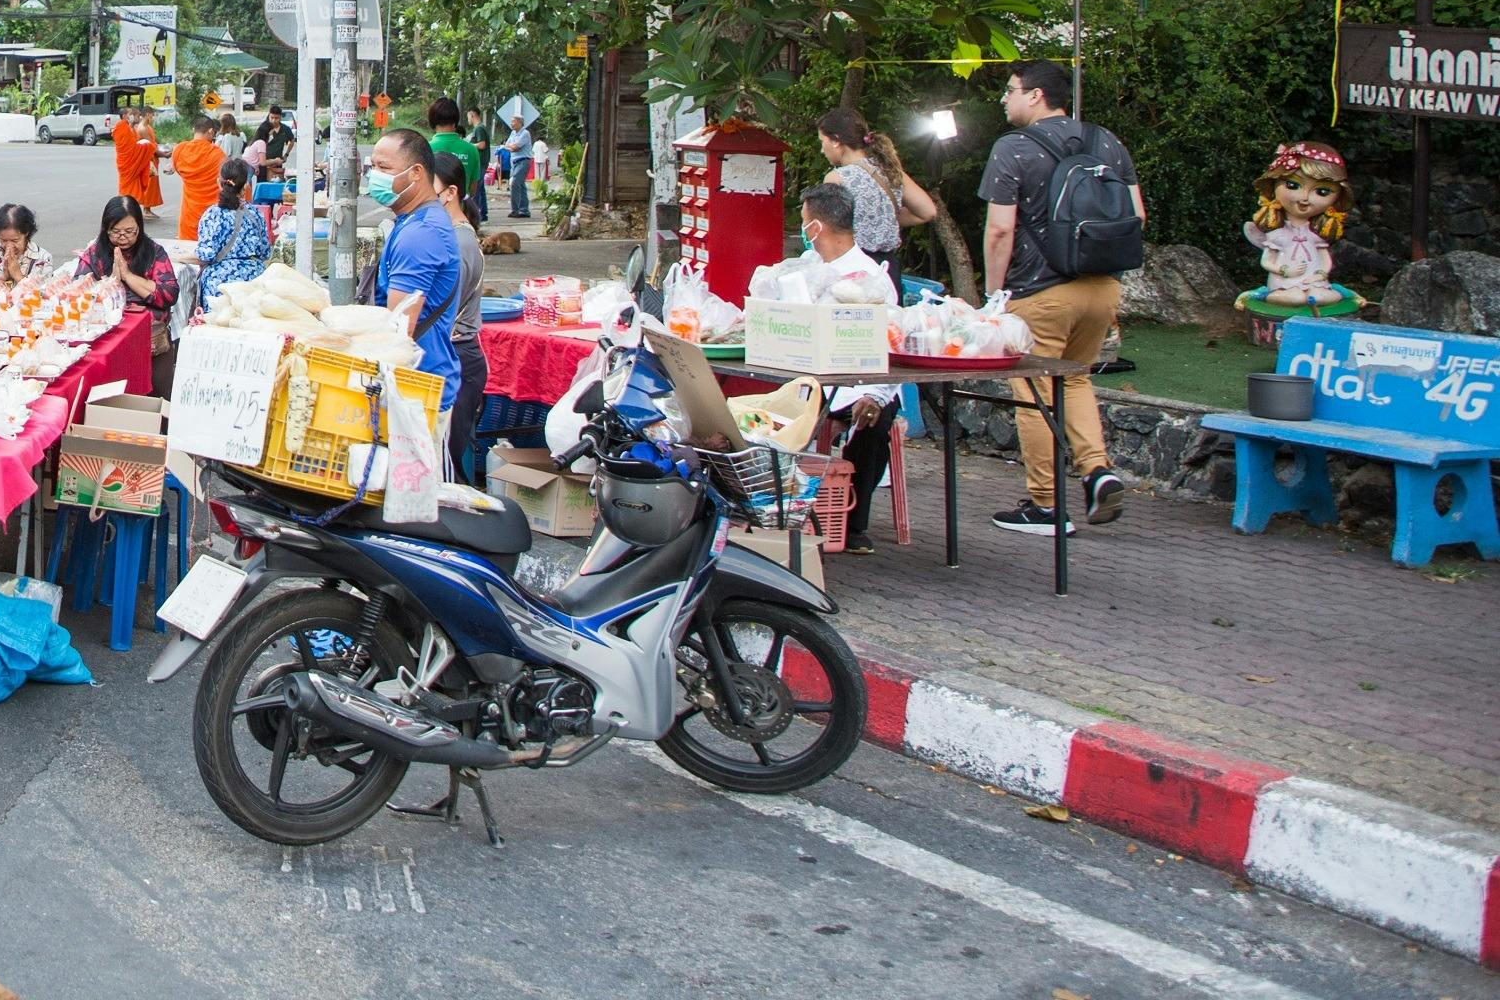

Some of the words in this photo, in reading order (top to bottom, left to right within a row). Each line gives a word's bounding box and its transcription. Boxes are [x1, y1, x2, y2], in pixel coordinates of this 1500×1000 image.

[155, 10, 174, 20] FRIEND
[136, 43, 150, 56] 1155
[1348, 83, 1405, 108] HUAY
[1409, 88, 1473, 113] KEAW
[1476, 93, 1500, 117] W
[1437, 354, 1500, 377] UPER
